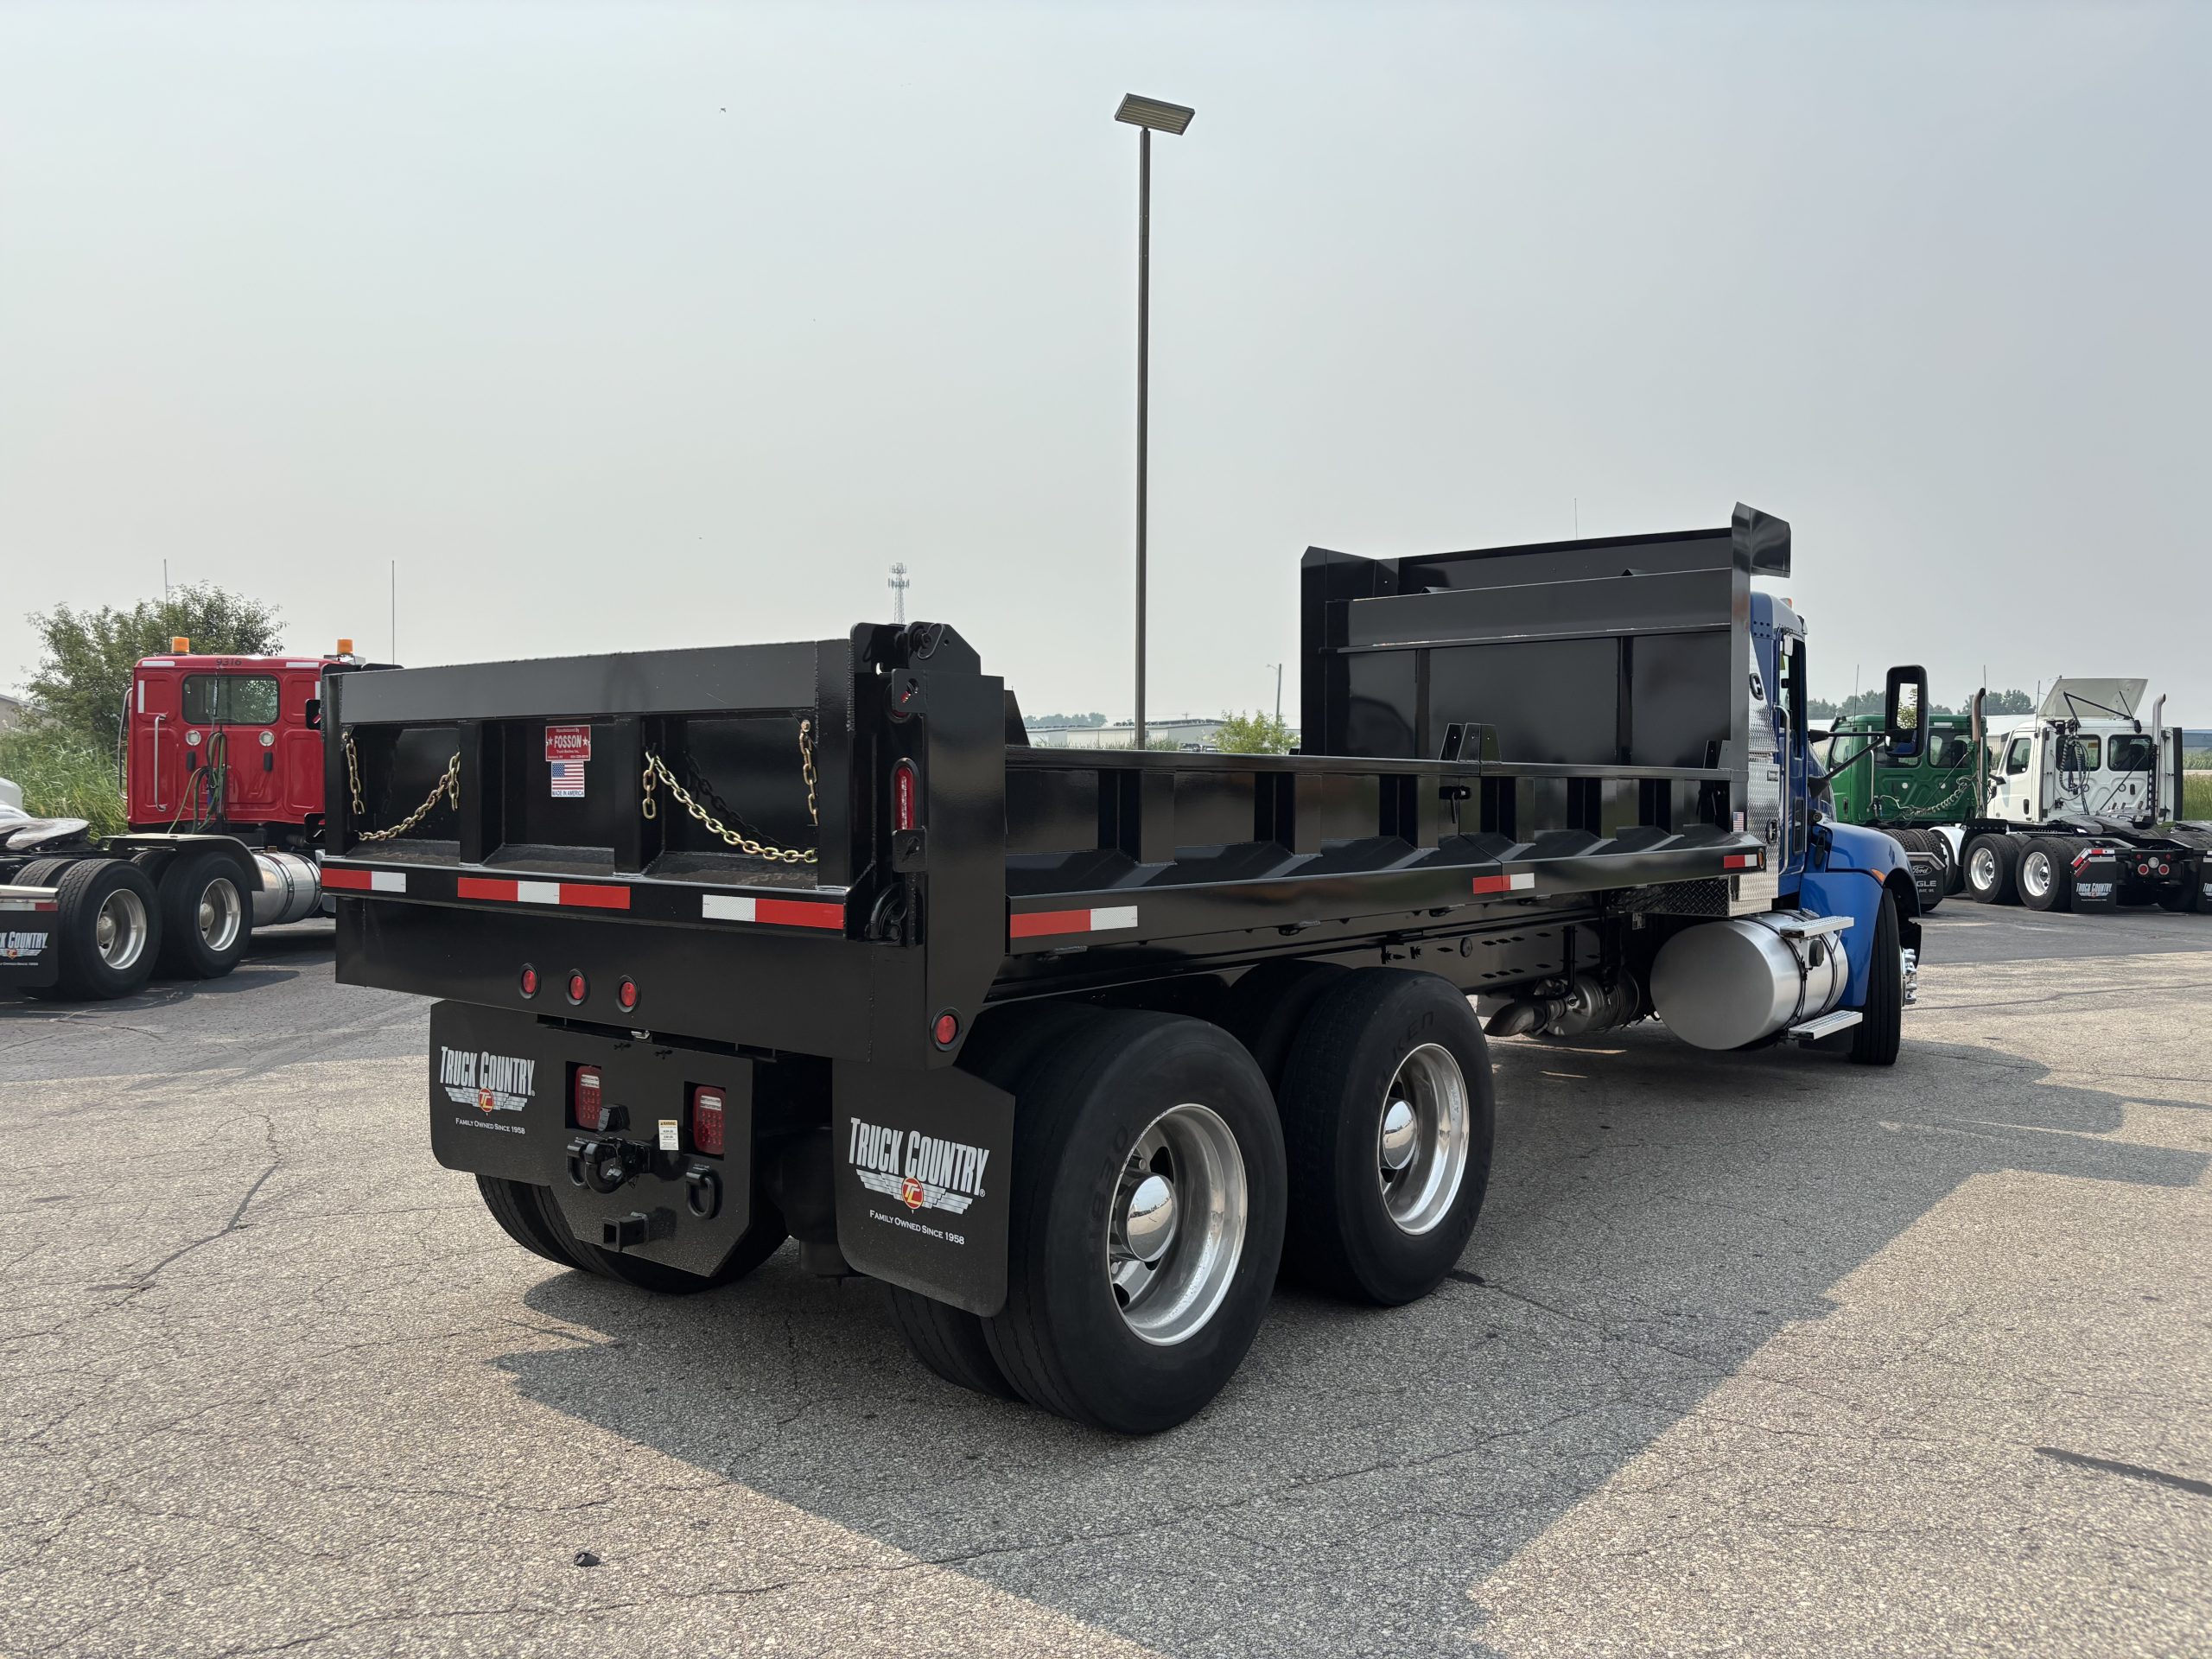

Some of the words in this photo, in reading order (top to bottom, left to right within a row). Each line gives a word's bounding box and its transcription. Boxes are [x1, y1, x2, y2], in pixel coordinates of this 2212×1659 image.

[554, 734, 582, 749] FOSSON
[1912, 866, 1929, 874] Ford
[8, 931, 48, 949] COUNTRY
[440, 1046, 478, 1088] TRUCK
[480, 1051, 535, 1096] COUNTRY
[455, 1117, 474, 1127] FAMILY
[474, 1120, 494, 1129] OWNED
[494, 1123, 511, 1132] SINCE
[511, 1126, 525, 1135] 1958
[849, 1116, 904, 1174] TRUCK
[905, 1130, 990, 1196] COUNTRY
[869, 1209, 894, 1224] FAMILY
[894, 1217, 921, 1232] OWNED
[922, 1224, 944, 1239] SINCE
[944, 1231, 965, 1245] 1958
